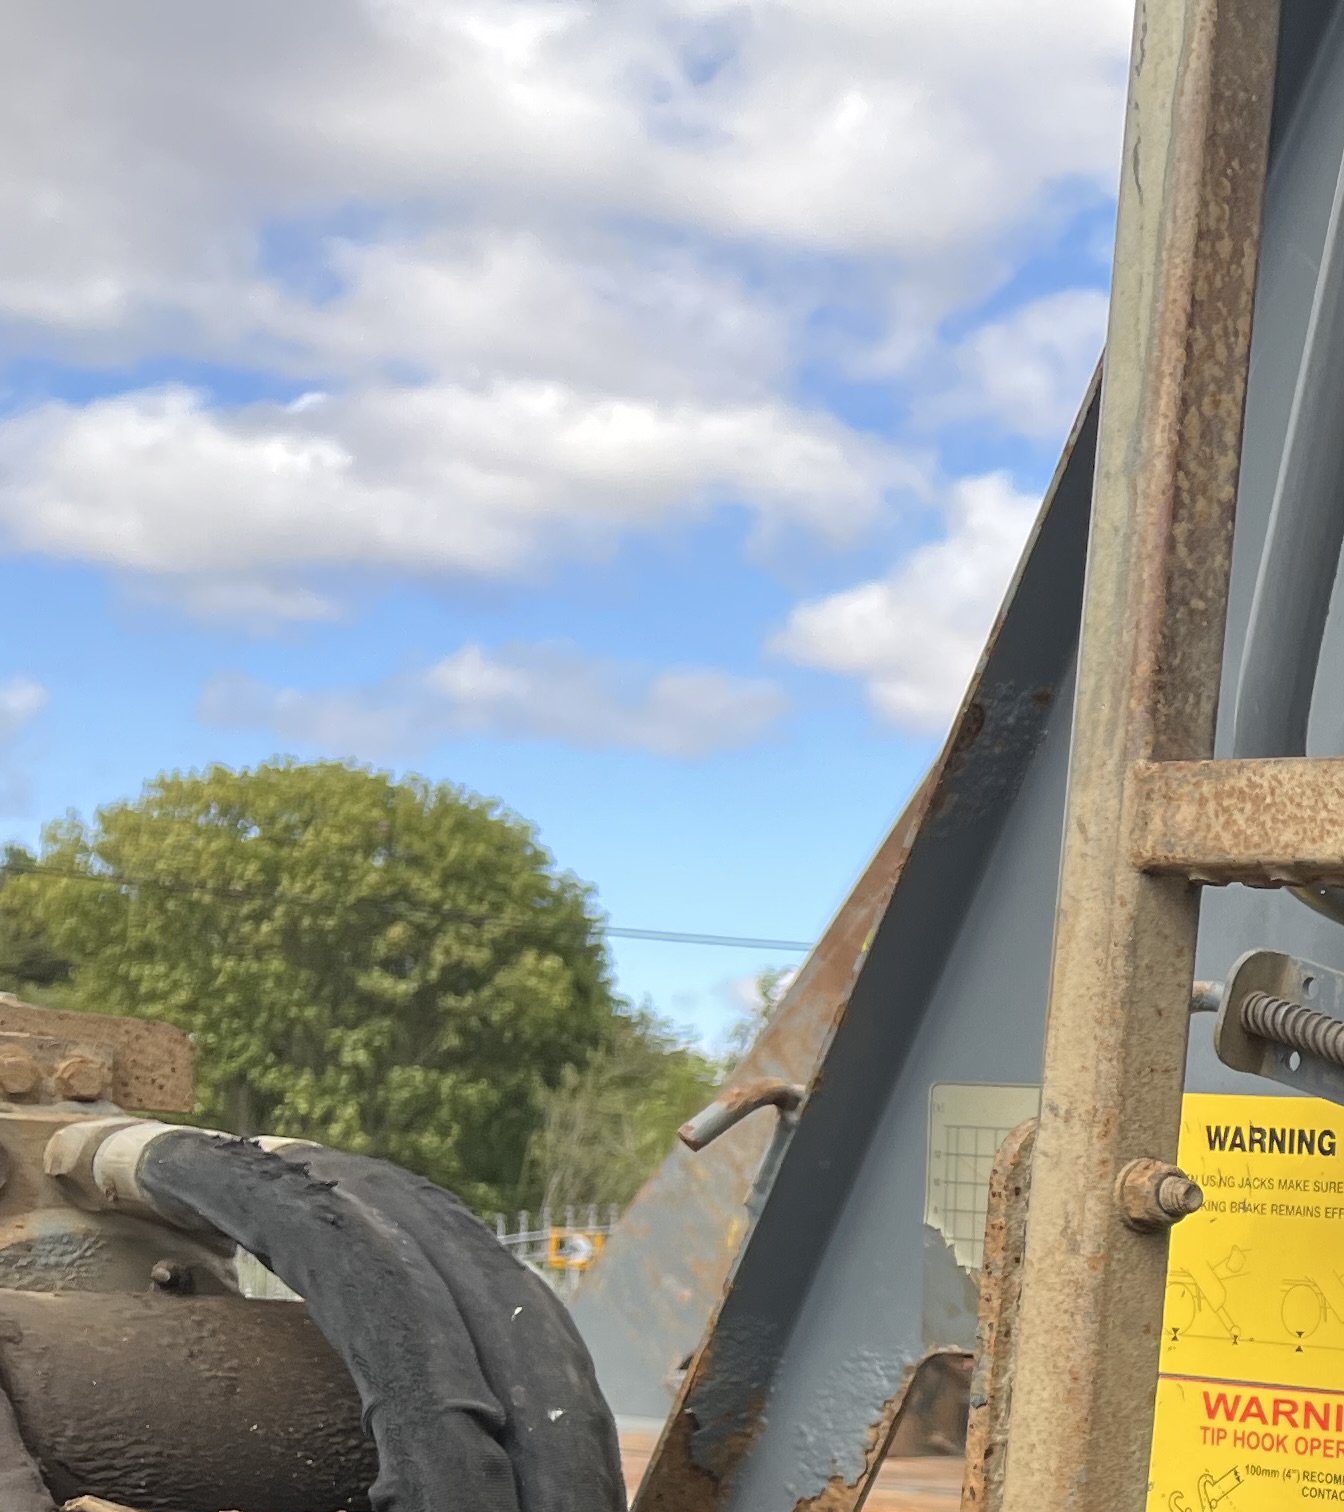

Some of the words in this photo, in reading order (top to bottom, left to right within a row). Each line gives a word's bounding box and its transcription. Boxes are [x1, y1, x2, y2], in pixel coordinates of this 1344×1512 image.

[1206, 1125, 1336, 1156] WARNING
[1201, 1174, 1235, 1188] USING
[1238, 1177, 1274, 1190] JACKS
[1277, 1179, 1310, 1192] MAKE
[1313, 1180, 1343, 1194] SURE
[1200, 1200, 1227, 1213] KING
[1230, 1202, 1267, 1215] BRAKE
[1271, 1204, 1321, 1218] REMAINS
[1200, 1426, 1227, 1446] TIP
[1233, 1429, 1289, 1454] HOOK
[1245, 1464, 1280, 1478] 100mm
